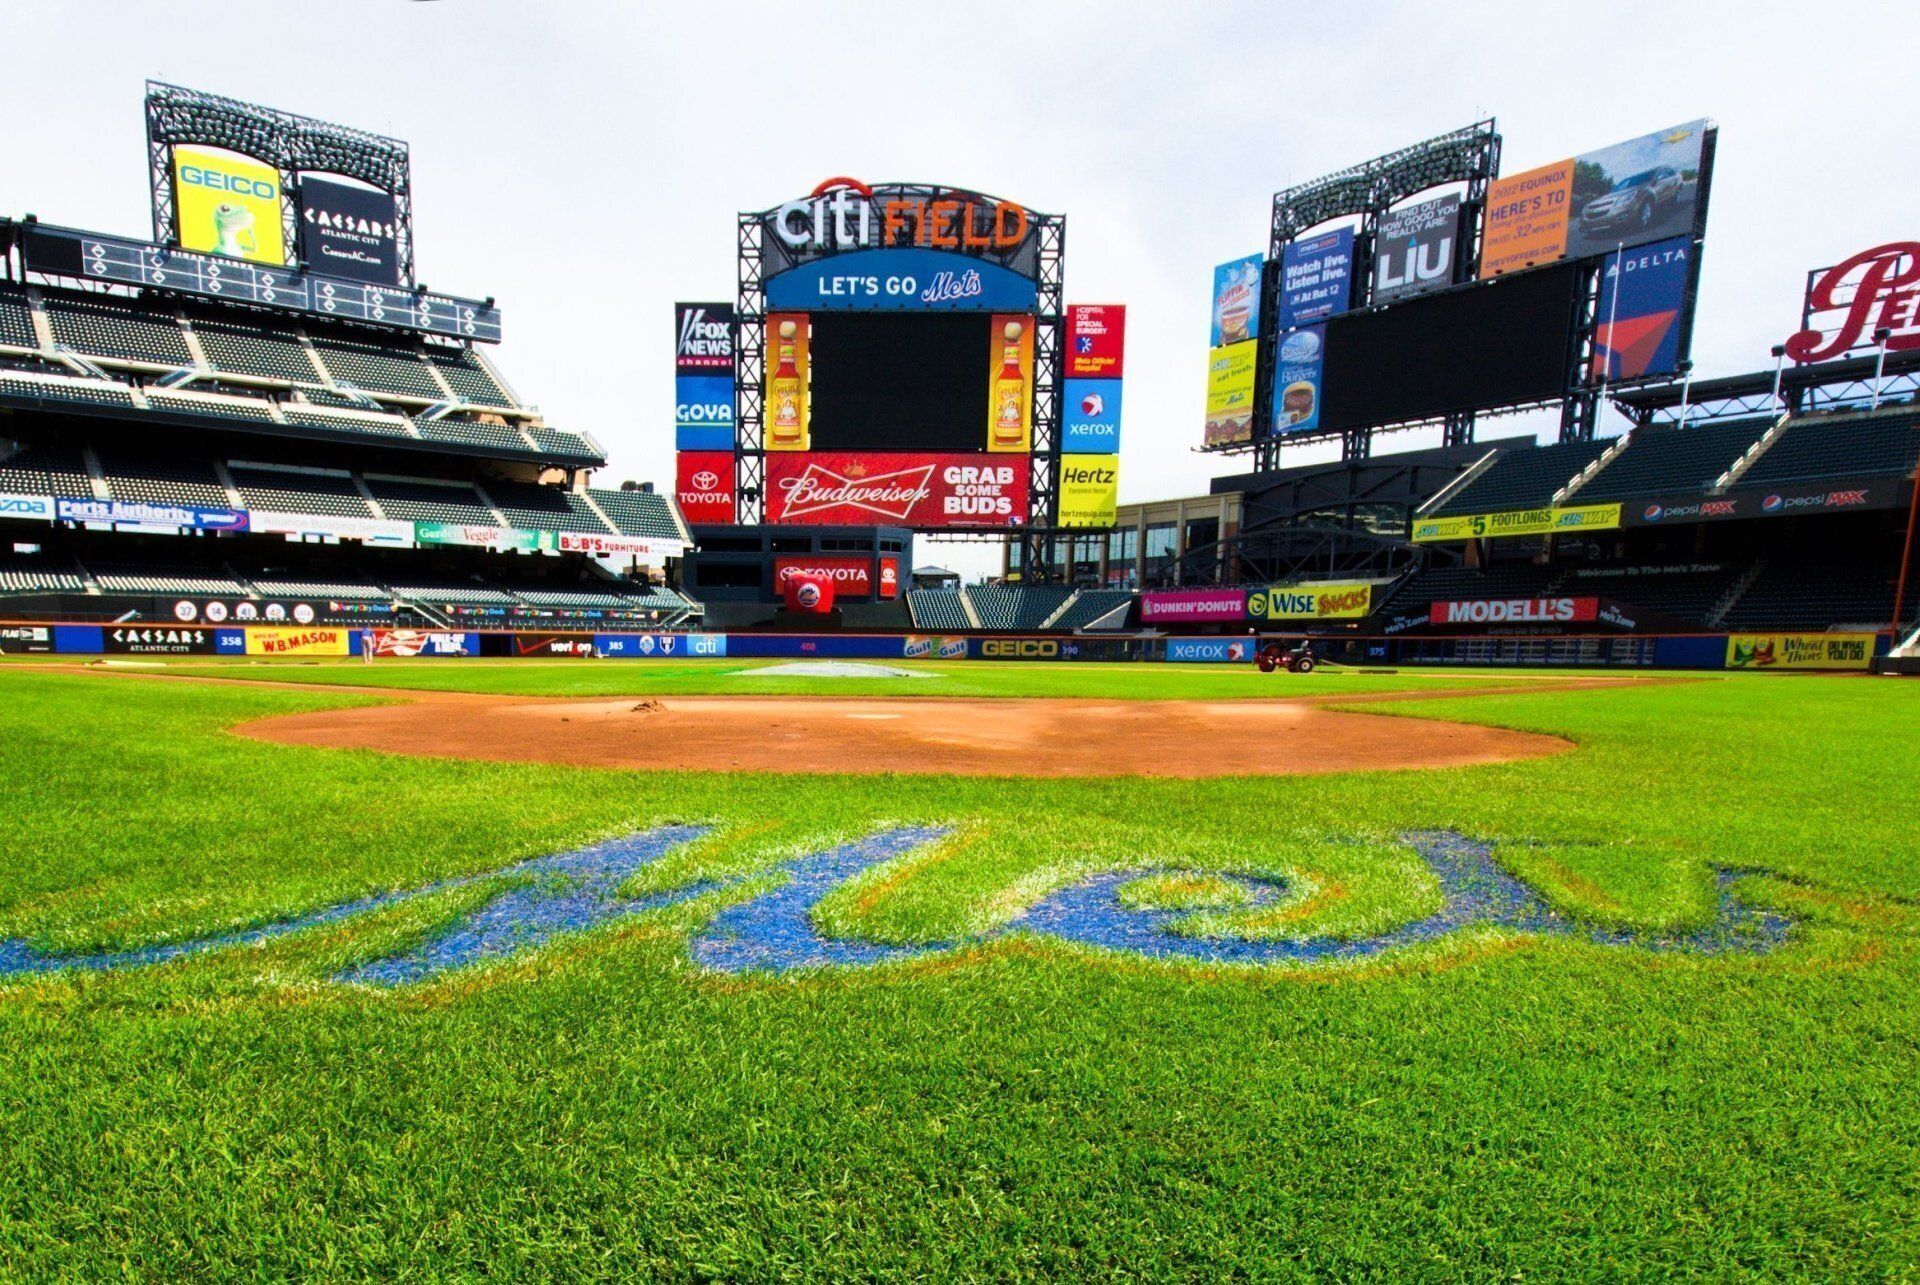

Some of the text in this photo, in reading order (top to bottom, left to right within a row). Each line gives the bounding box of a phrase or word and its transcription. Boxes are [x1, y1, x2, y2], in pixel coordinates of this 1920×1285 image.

[180, 165, 275, 200] GEICO
[1494, 170, 1568, 200] 2012 EQUINOX
[1395, 199, 1443, 220] FIND OUT
[1490, 189, 1566, 222] HERE'S TO
[304, 208, 395, 240] CAESARS
[885, 201, 1028, 245] FIELD
[1379, 203, 1460, 234] HOW GOOD YOU
[321, 228, 381, 246] ATLANTIC CITY
[1386, 223, 1423, 240] REALLY
[1513, 224, 1532, 240] 32
[1378, 237, 1451, 290] LIU
[1486, 244, 1560, 268] CHEVYOFFERS.COM
[1626, 249, 1686, 272] DELTA
[1286, 255, 1348, 279] Watch live.
[819, 269, 983, 302] LET'S GO Mets
[1286, 268, 1347, 291] Listen live.
[1301, 284, 1340, 303] At Bat 12
[694, 322, 731, 339] FOX
[1075, 320, 1104, 328] SPECIAL
[1075, 327, 1107, 335] SURGERY
[684, 340, 732, 356] NEWS
[678, 358, 733, 366] channel
[676, 404, 732, 421] GOYA
[1070, 423, 1115, 436] xerox
[943, 466, 1014, 484] GRAB
[1064, 467, 1115, 484] Hertz
[679, 492, 732, 504] TOYOTA
[779, 477, 930, 504] Budweiser
[955, 485, 1002, 496] SOME
[943, 497, 1012, 515] BUDS
[1784, 489, 1869, 509] pepsi MAX
[59, 500, 109, 517] Parts
[1664, 500, 1738, 519] pepsi MAX
[1416, 521, 1466, 537] SUBWAY
[1491, 511, 1552, 526] FOOTLONGS
[1556, 508, 1618, 527] SUBWAY
[463, 528, 498, 544] Veggie
[561, 537, 602, 551] BOB'S
[604, 543, 649, 553] FURNITURE
[1627, 567, 1639, 576] To
[1641, 566, 1661, 575] The
[373, 604, 391, 612] Deck
[1199, 600, 1242, 612] DONUTS
[1273, 587, 1368, 617] WISE SNACKS
[1447, 598, 1575, 622] MODELL'S
[180, 606, 192, 616] 37
[489, 607, 505, 616] Deck
[588, 610, 602, 618] Deck
[1405, 615, 1430, 628] Zone
[1614, 614, 1637, 630] Zone
[112, 630, 204, 644] CAESARS
[221, 636, 242, 646] 358
[1784, 637, 1824, 652] Wheat
[1828, 640, 1866, 650] DO WHAT
[551, 641, 592, 653] verizon
[608, 641, 624, 650] 385
[695, 640, 718, 654] citi
[906, 641, 931, 657] Gulf
[940, 641, 965, 657] Gulf
[982, 640, 1058, 656] GEICO
[1062, 646, 1078, 655] 390
[1175, 643, 1223, 658] xerox
[1369, 646, 1385, 656] 375
[1781, 650, 1823, 663] Thins
[1828, 650, 1865, 661] YOU DO
